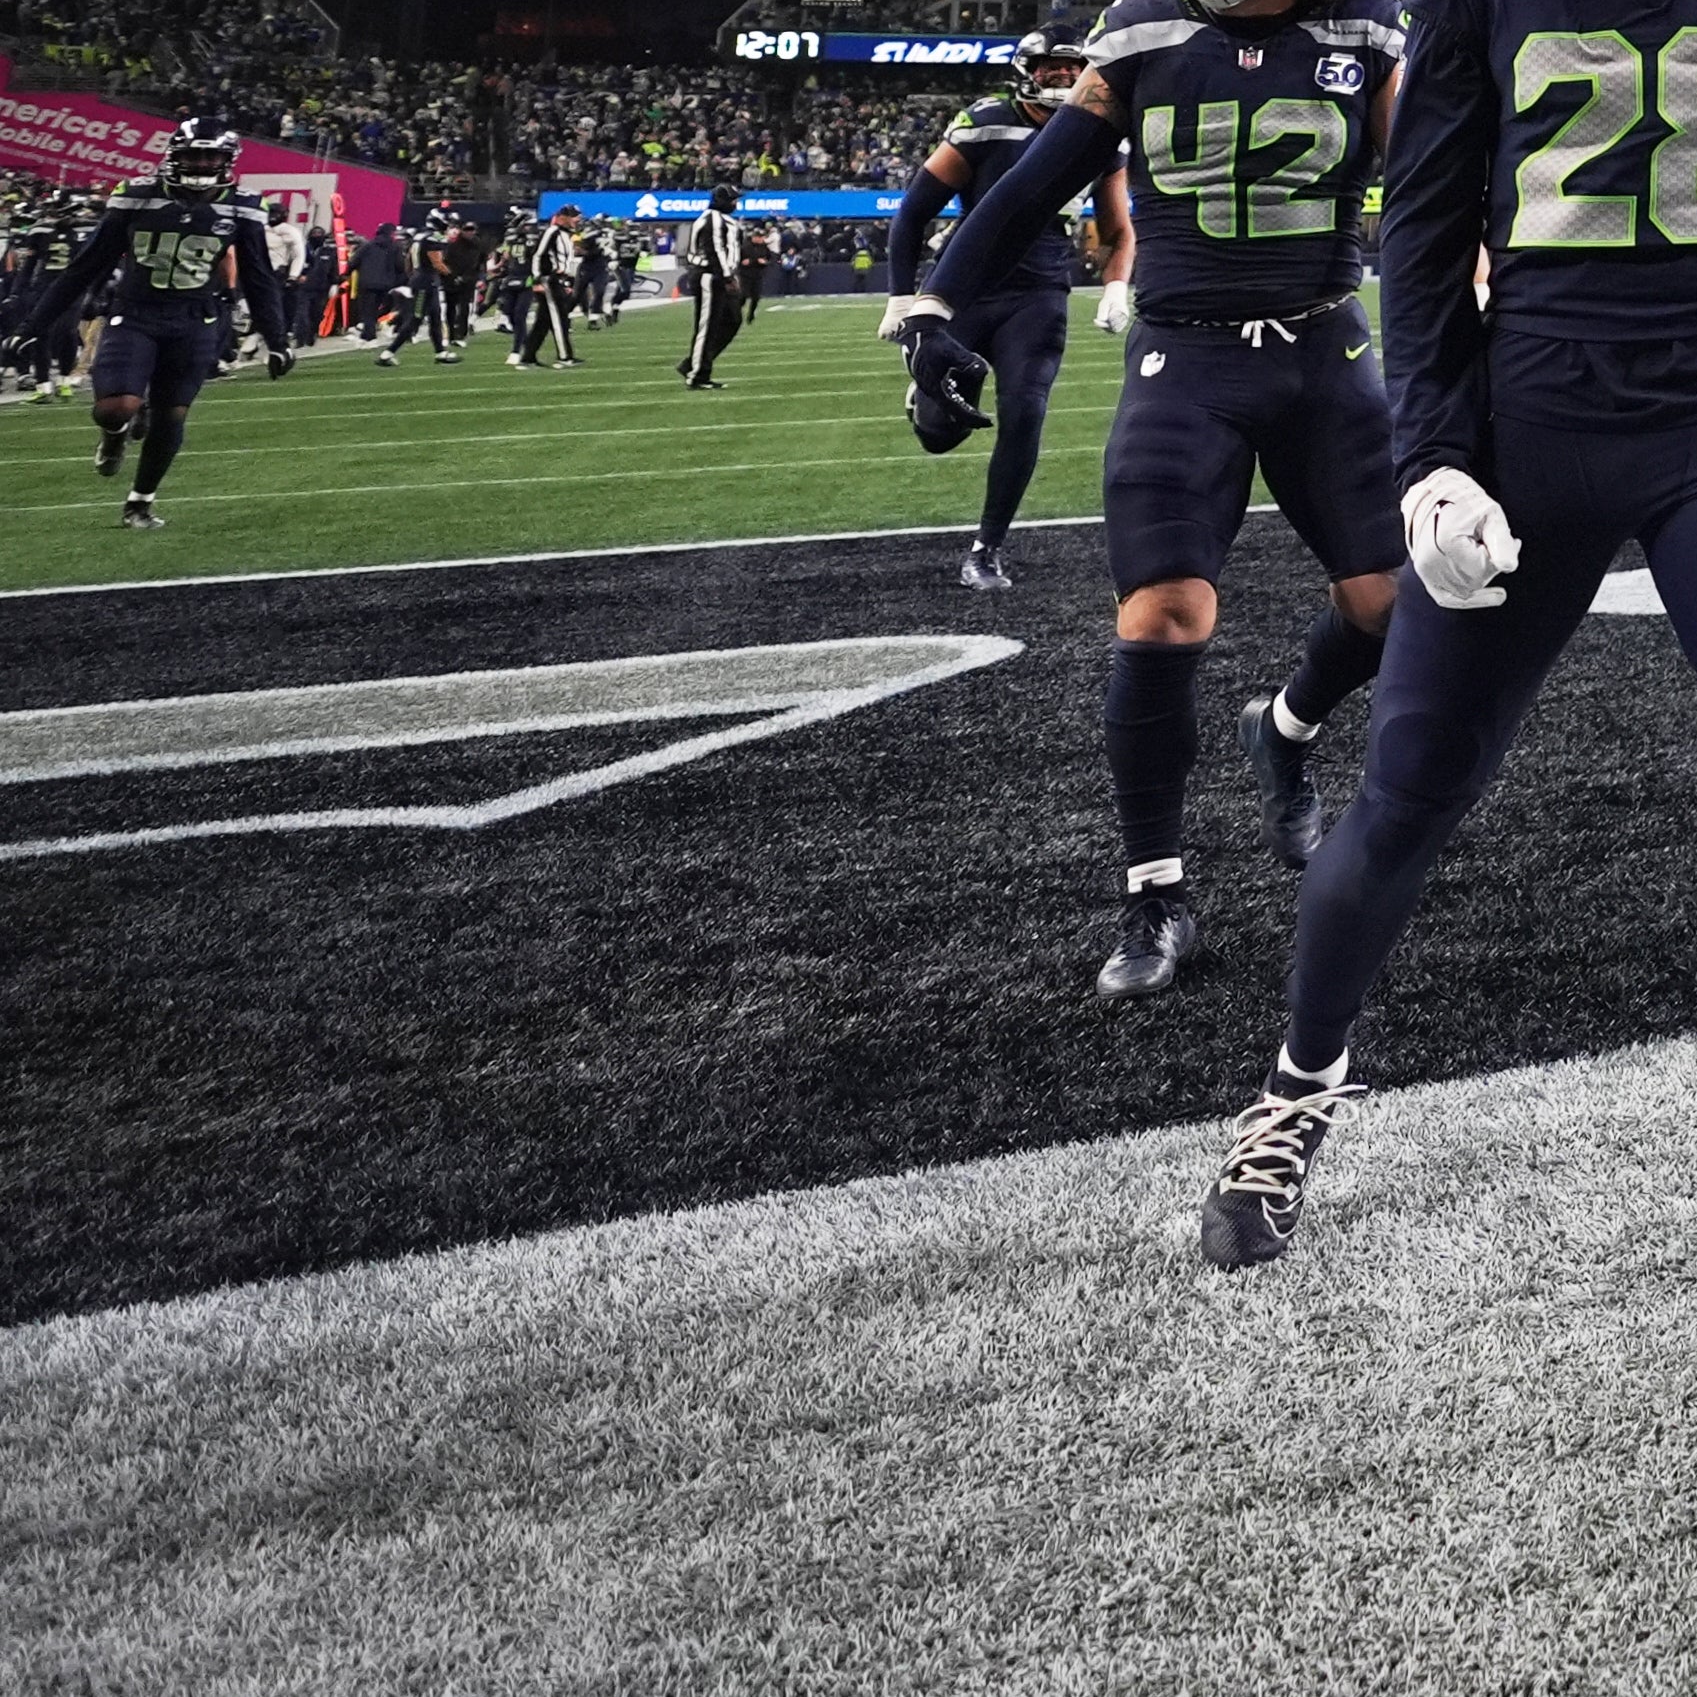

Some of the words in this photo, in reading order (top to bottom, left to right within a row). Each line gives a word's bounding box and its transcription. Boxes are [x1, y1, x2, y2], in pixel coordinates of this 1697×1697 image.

[735, 30, 820, 60] 12:07
[1316, 59, 1365, 88] 50
[0, 97, 143, 148] merica's
[66, 140, 162, 177] Netwo
[1143, 97, 1348, 239] 42
[745, 197, 790, 212] BANK
[133, 230, 223, 290] 48
